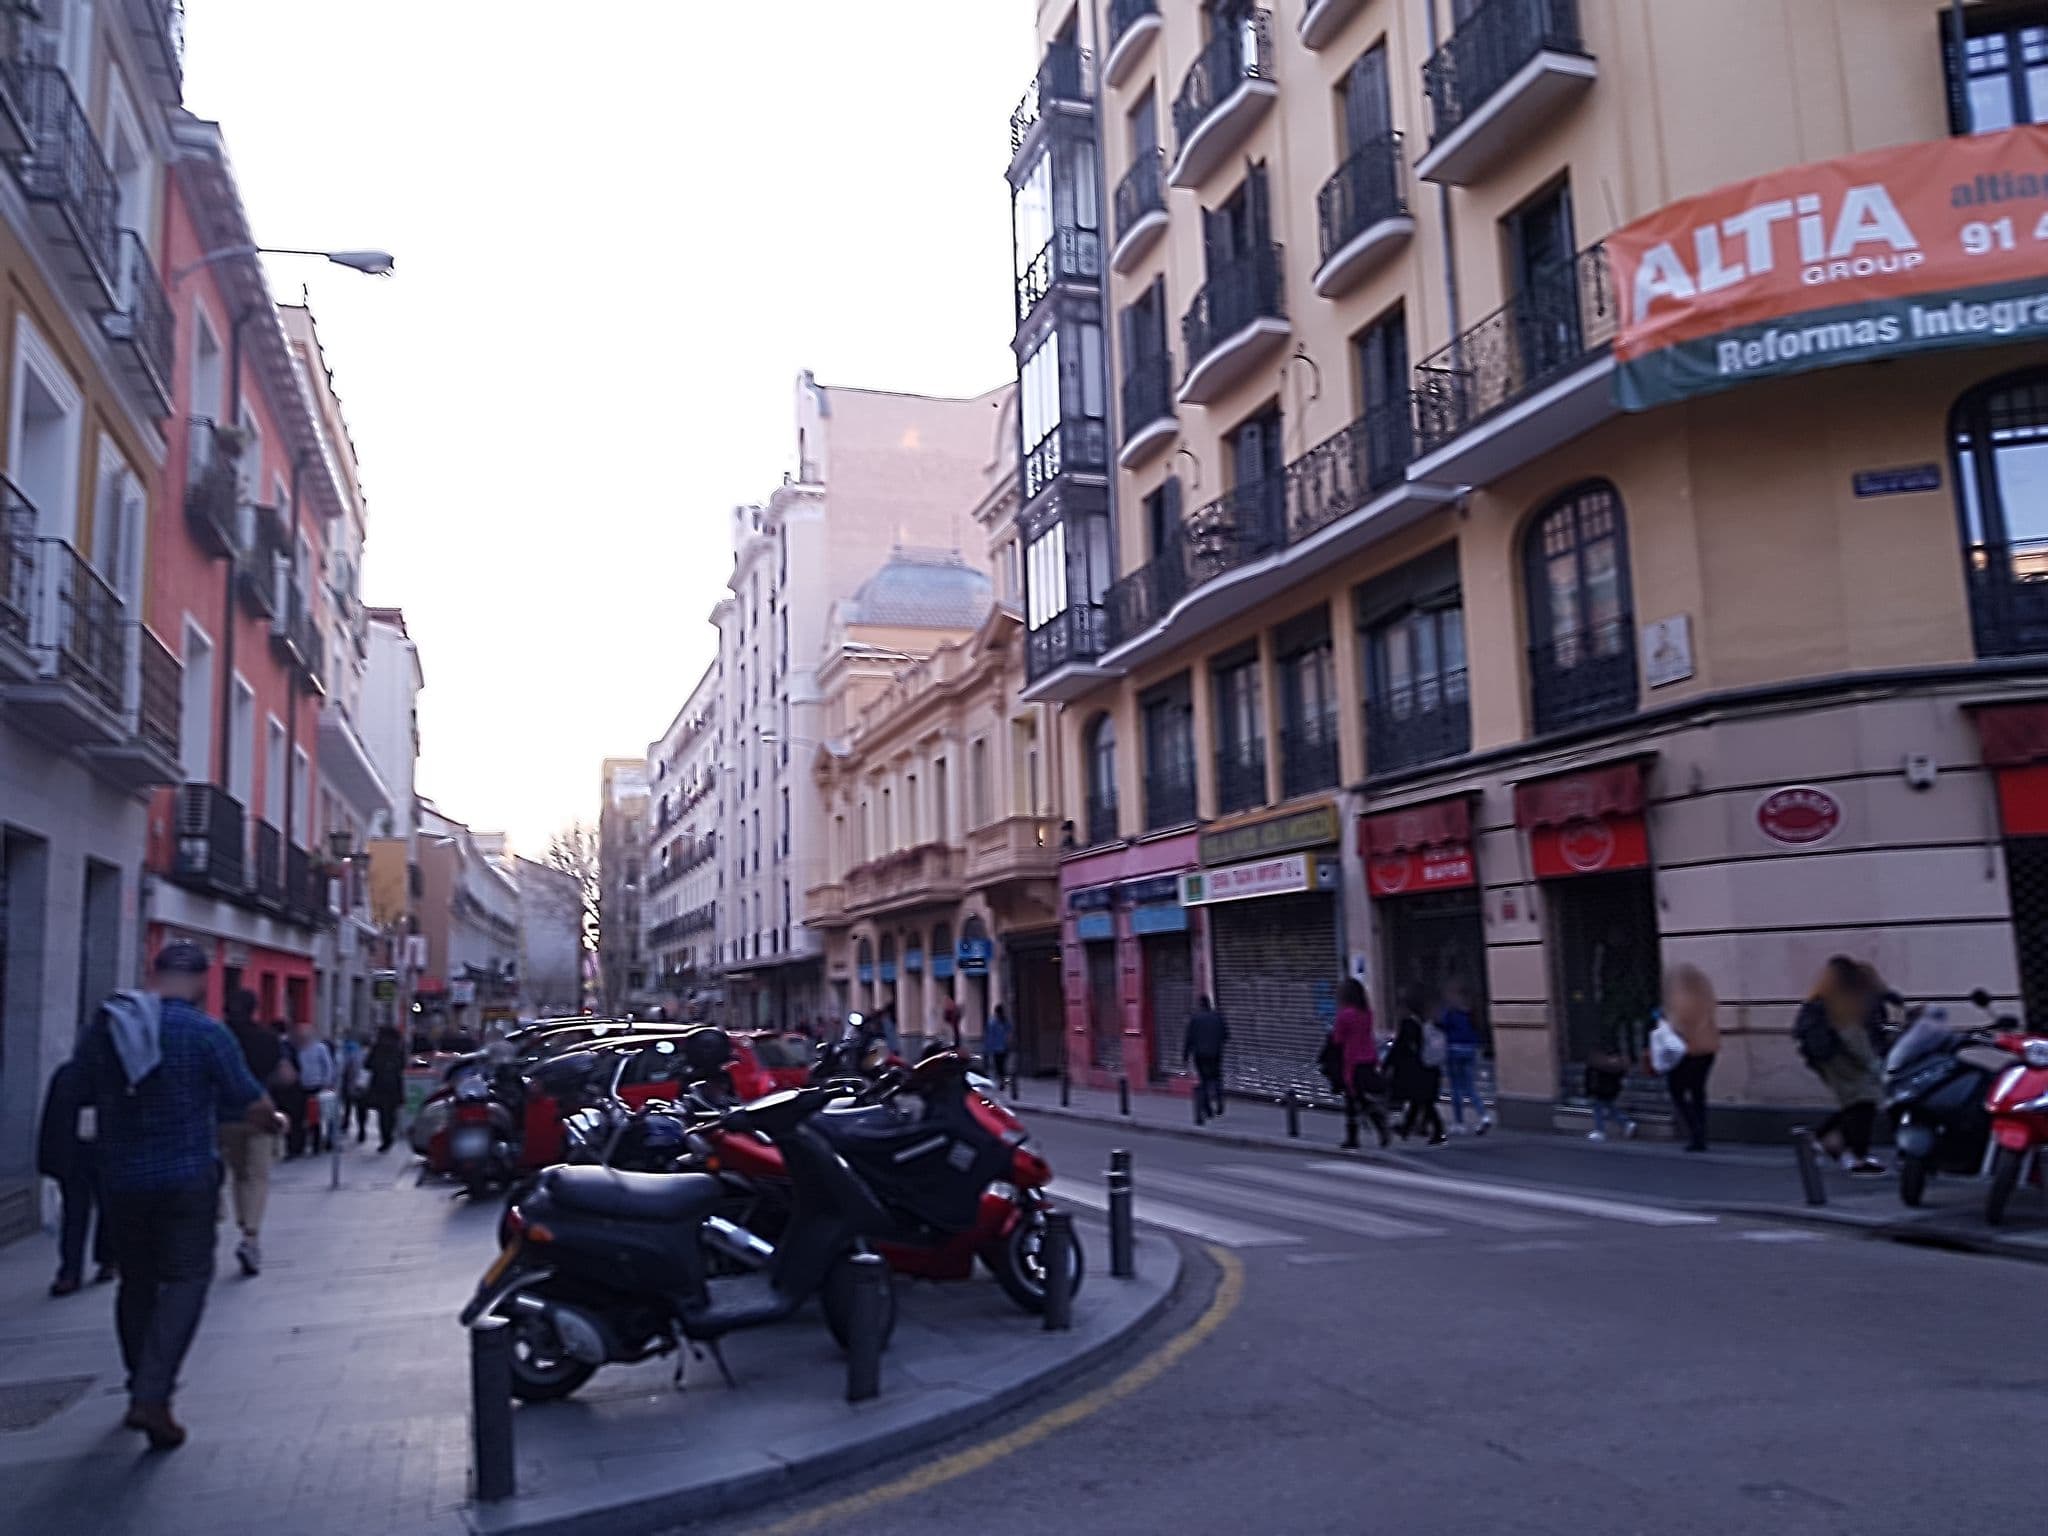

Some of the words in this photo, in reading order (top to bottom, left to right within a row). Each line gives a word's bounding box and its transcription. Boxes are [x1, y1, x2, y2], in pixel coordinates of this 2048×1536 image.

[1960, 217, 2016, 255] 91
[1803, 252, 1924, 285] GROUP
[1718, 315, 1899, 374] Reformas
